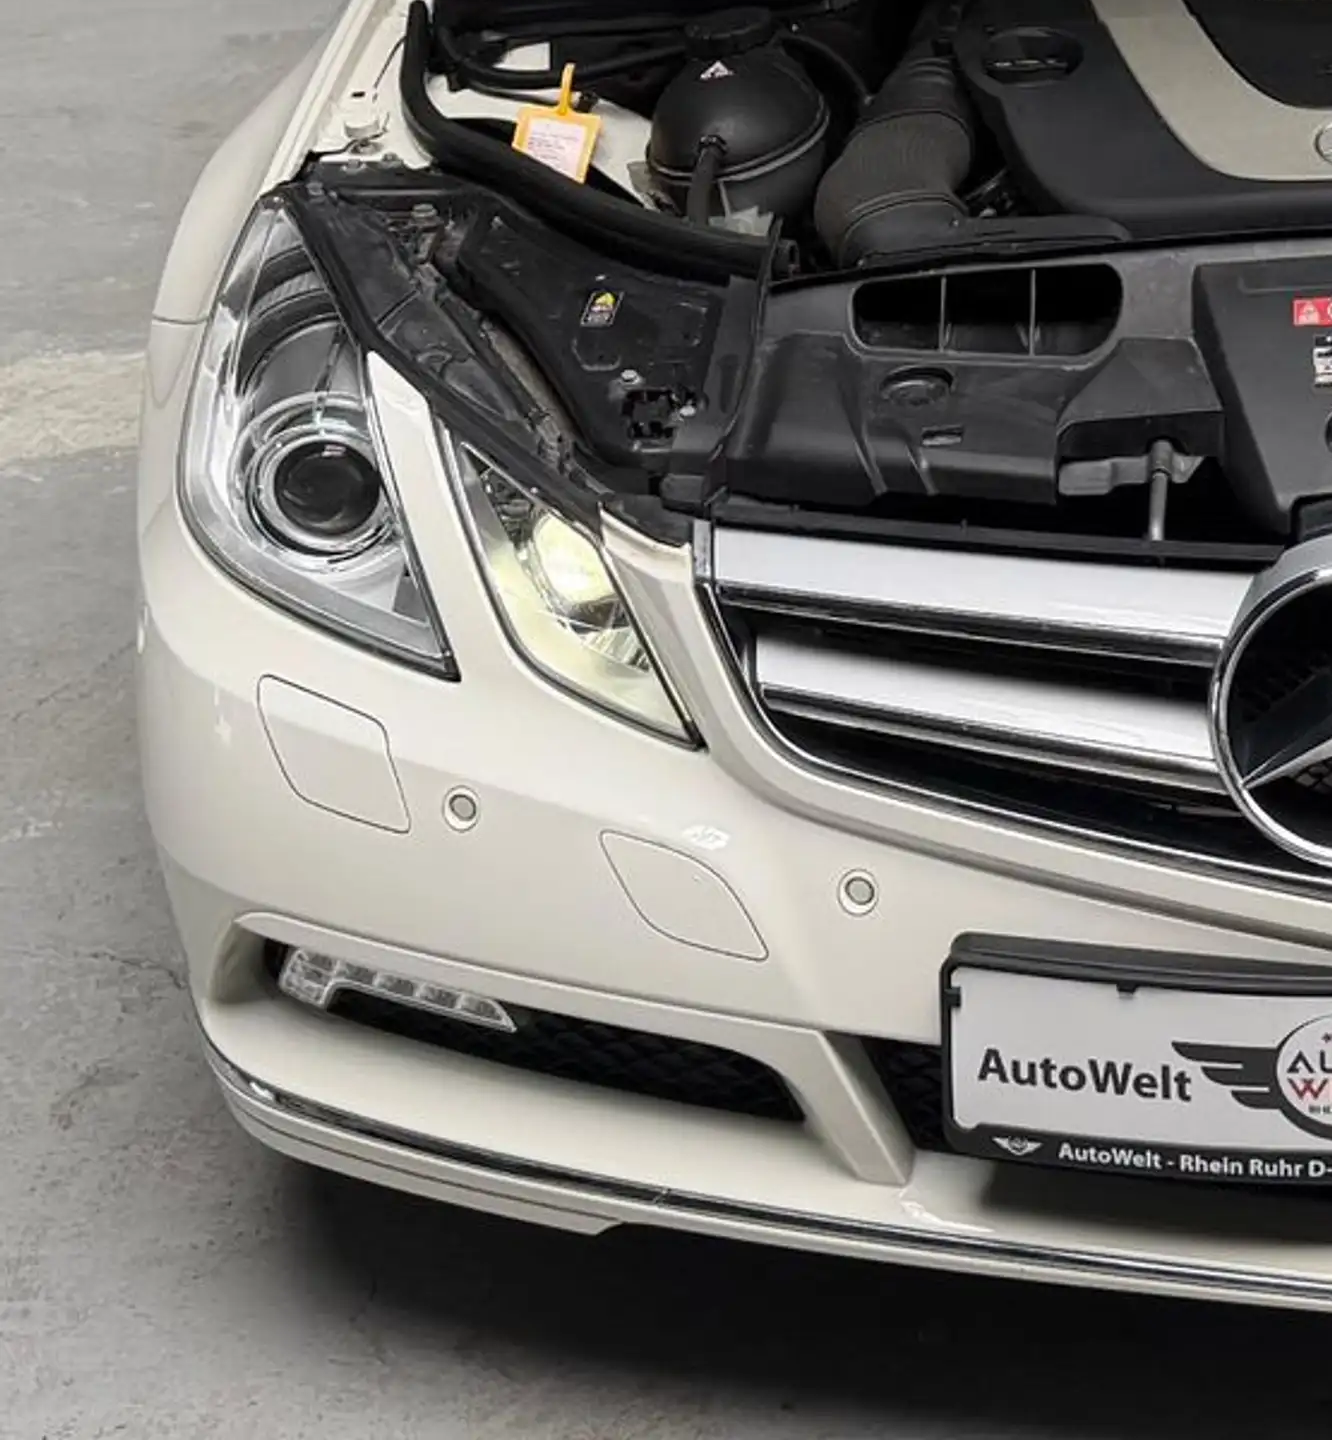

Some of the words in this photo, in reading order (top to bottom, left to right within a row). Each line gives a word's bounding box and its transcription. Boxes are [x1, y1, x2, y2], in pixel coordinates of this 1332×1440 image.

[978, 1048, 1192, 1102] AutoWelt
[1058, 1142, 1162, 1170] AutoWelt
[1180, 1154, 1244, 1175] Rhein
[1250, 1158, 1302, 1177] Ruhr
